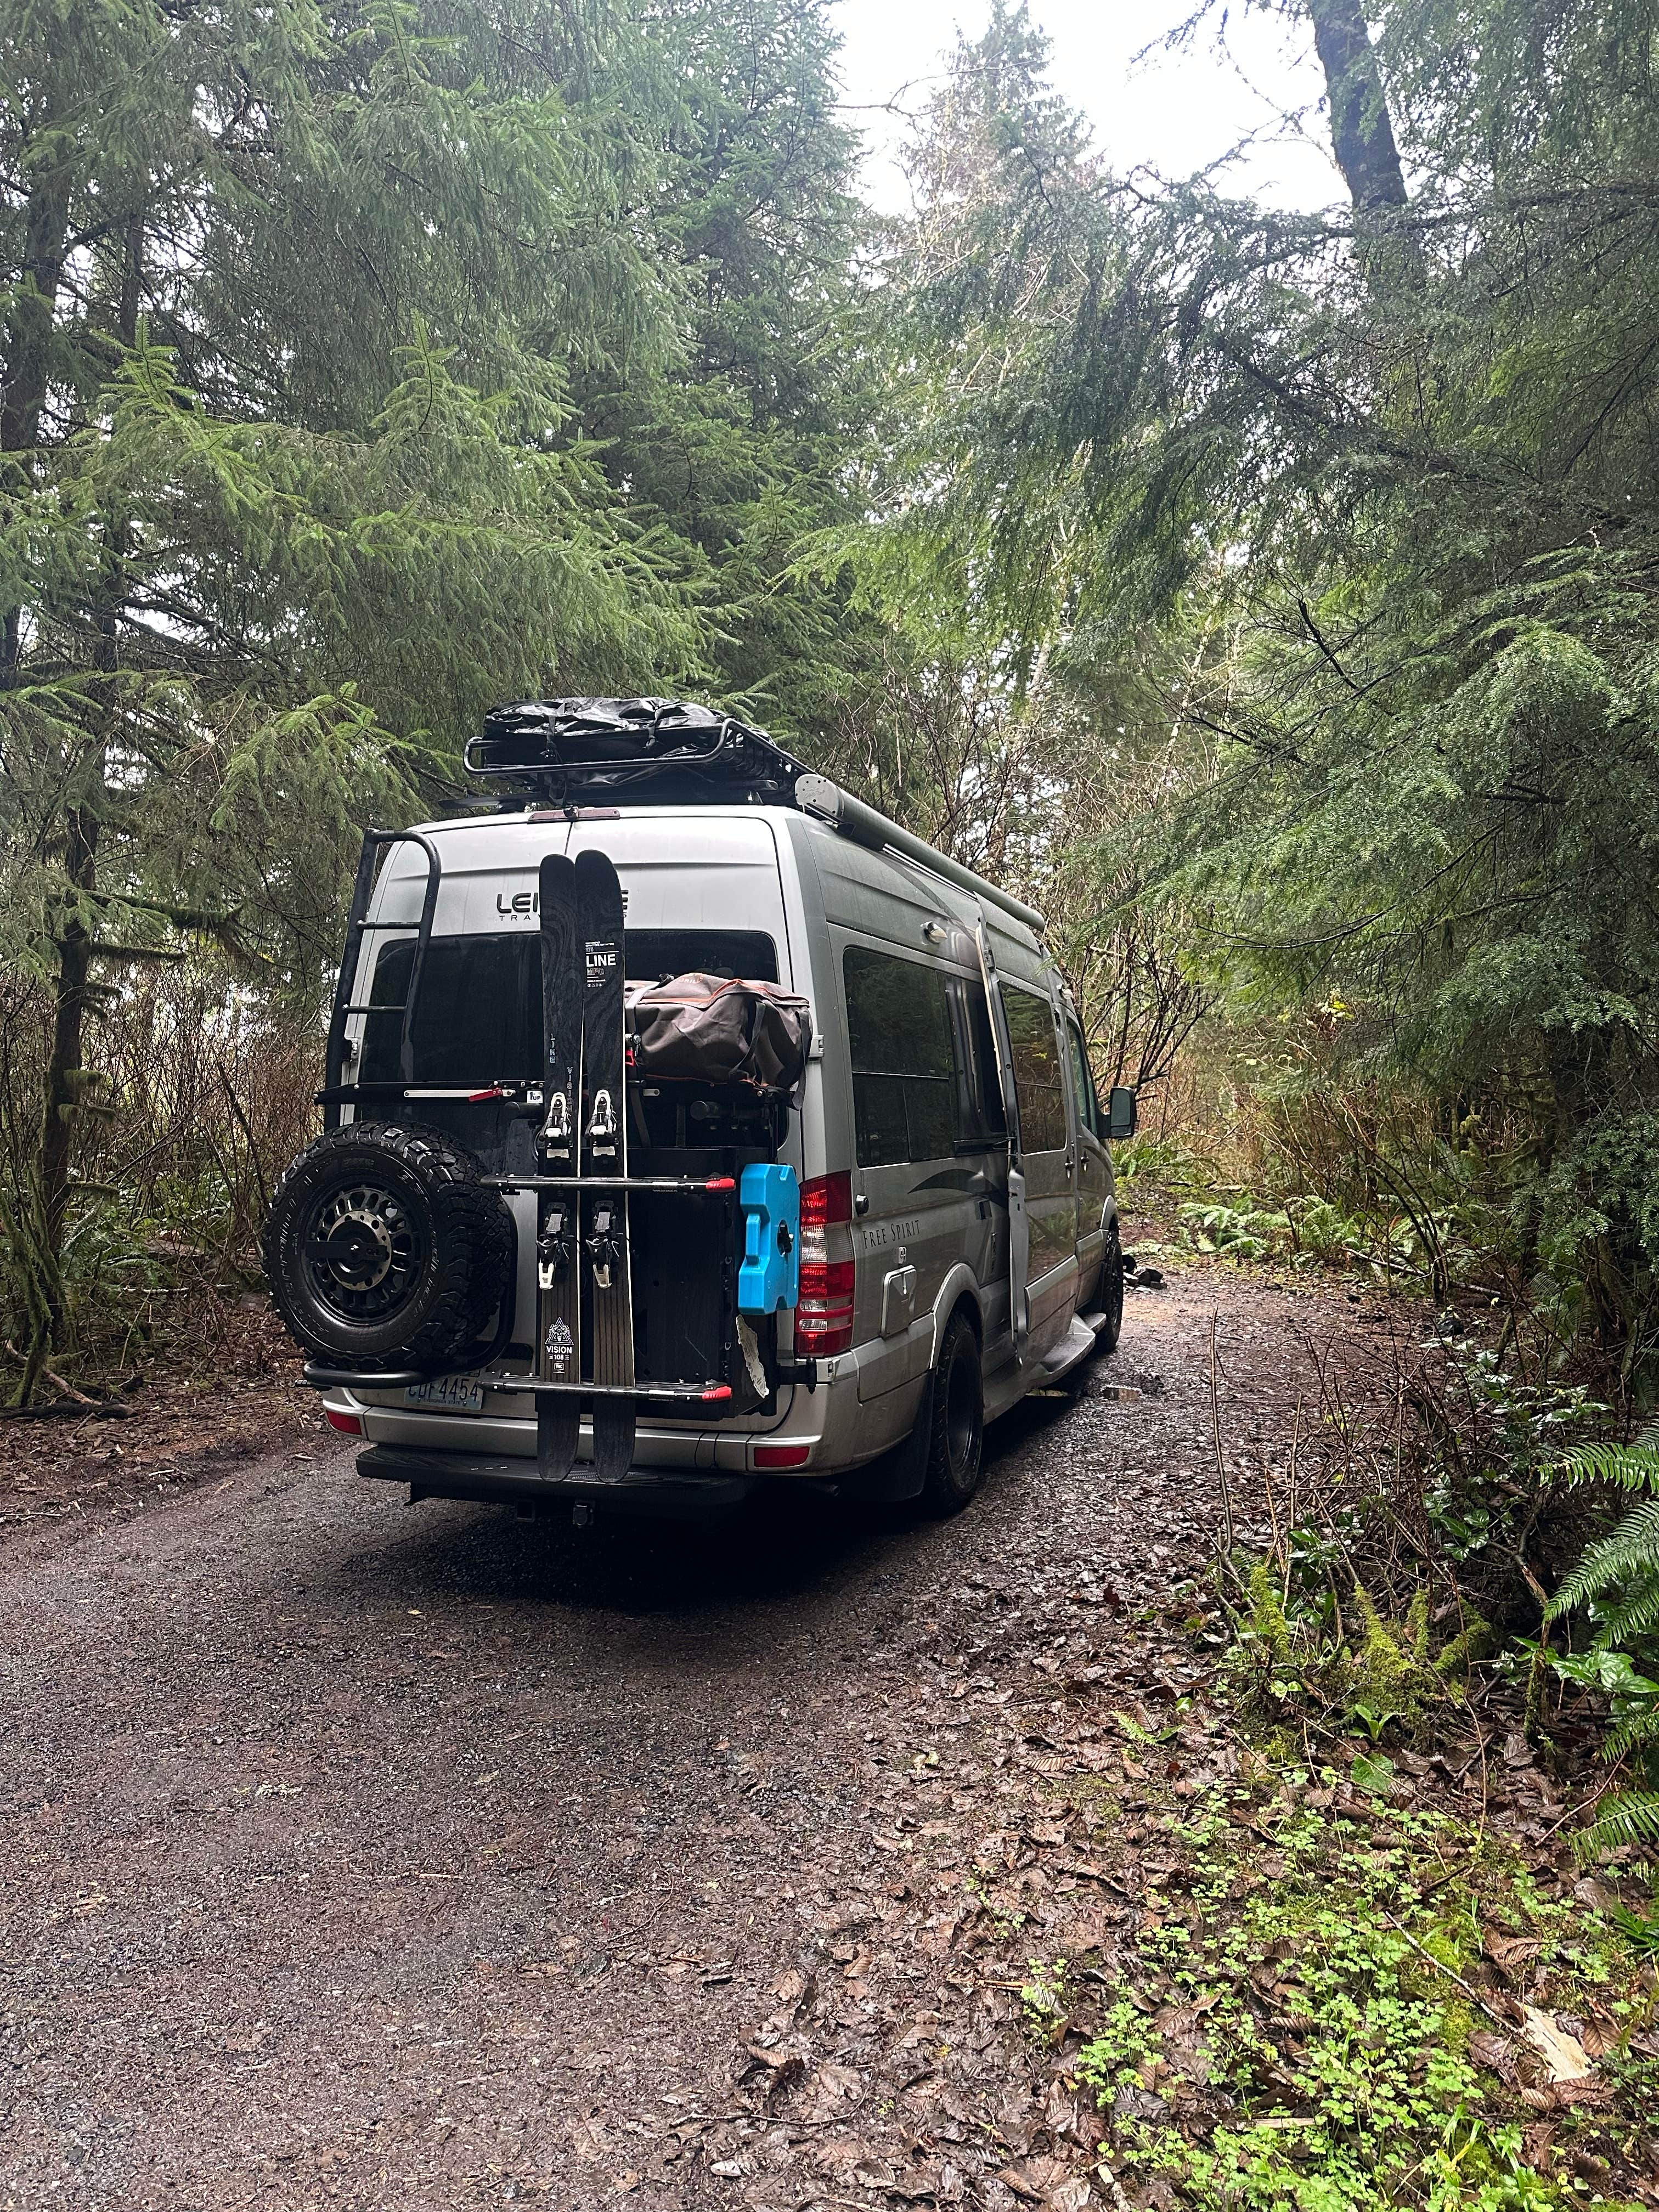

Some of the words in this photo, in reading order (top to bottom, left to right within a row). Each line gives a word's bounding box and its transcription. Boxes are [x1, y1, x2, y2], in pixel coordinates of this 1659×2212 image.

[586, 954, 616, 967] LINE
[862, 1228, 887, 1249] FREE
[890, 1220, 920, 1242] SPIRIT
[546, 1346, 572, 1354] VISION
[439, 1378, 478, 1402] 4454
